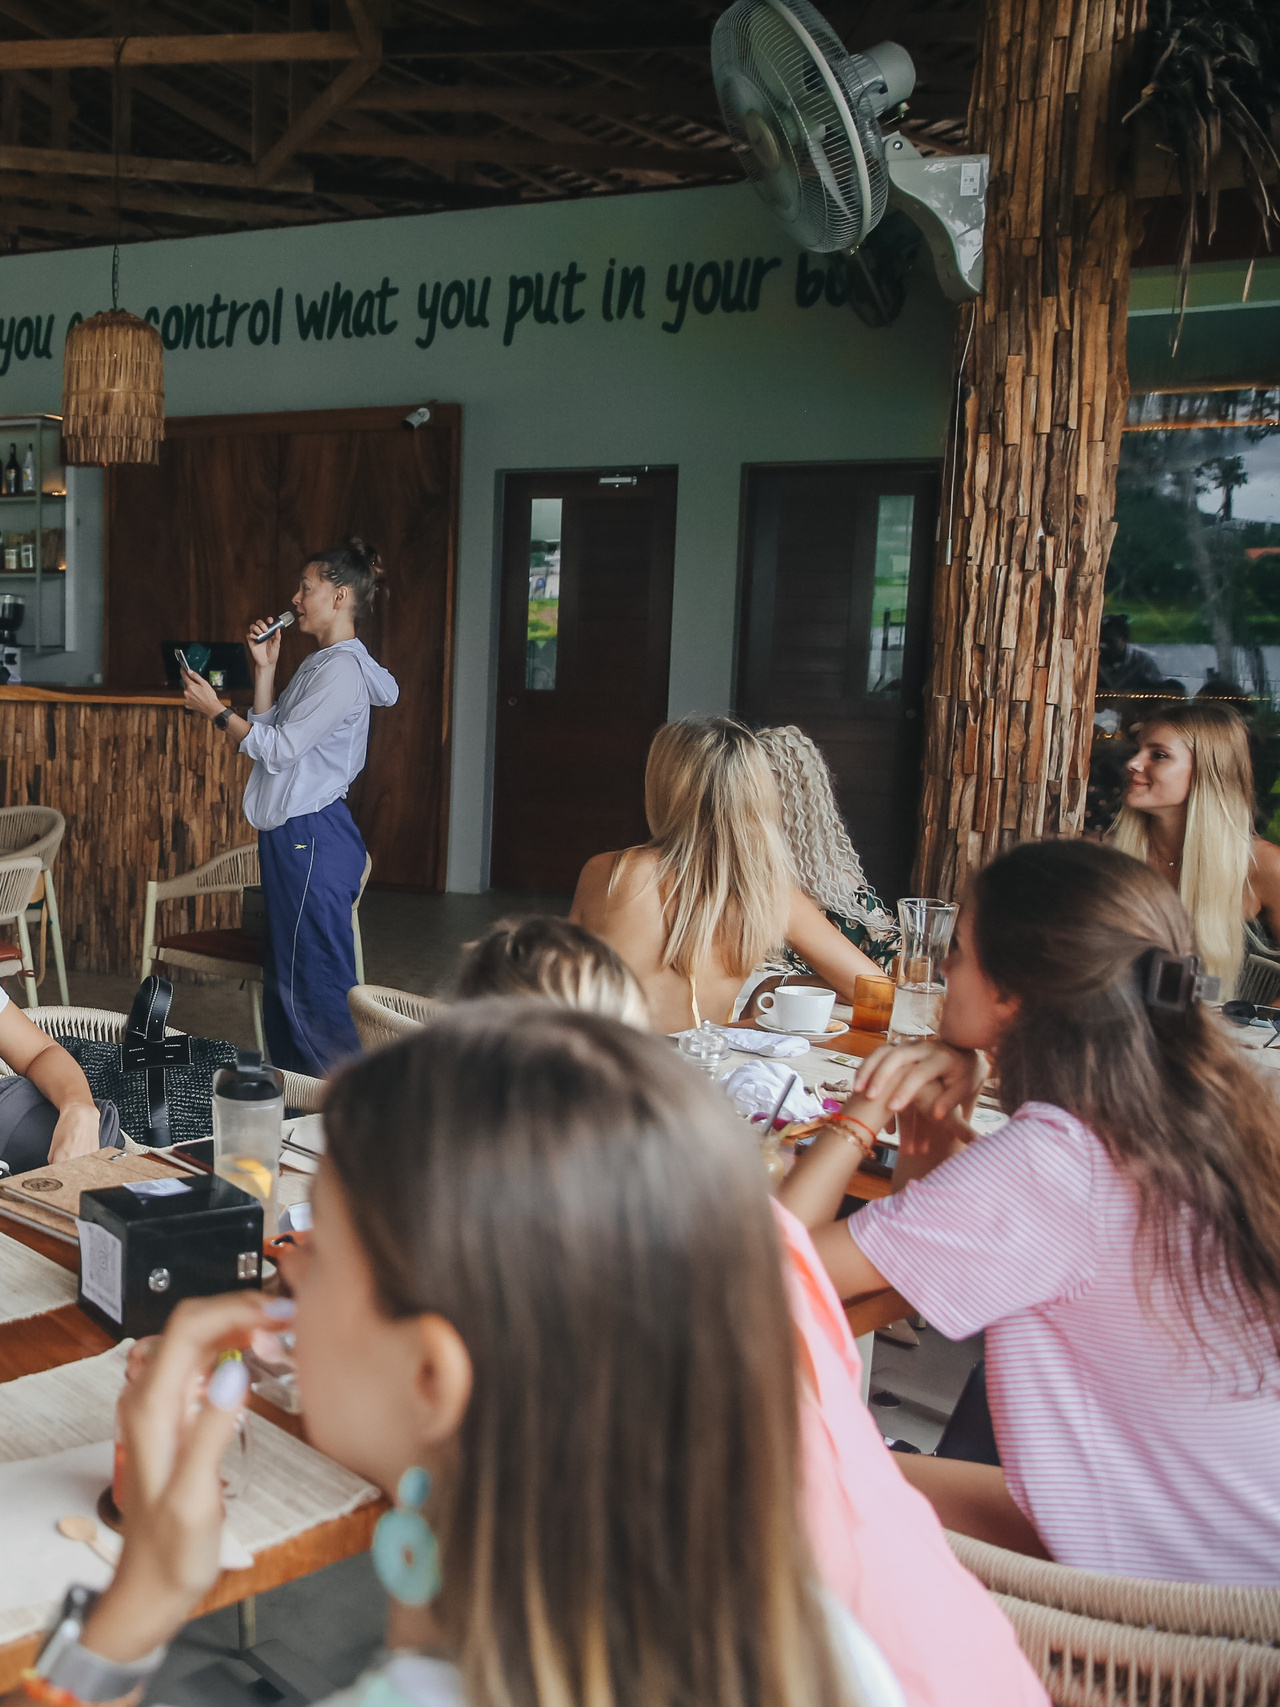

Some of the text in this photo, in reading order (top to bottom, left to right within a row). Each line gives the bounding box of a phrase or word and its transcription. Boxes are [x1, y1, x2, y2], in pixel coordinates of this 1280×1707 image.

[294, 276, 400, 341] what
[414, 275, 492, 350] you
[503, 261, 587, 347] put
[601, 257, 647, 322] in
[661, 256, 783, 334] your
